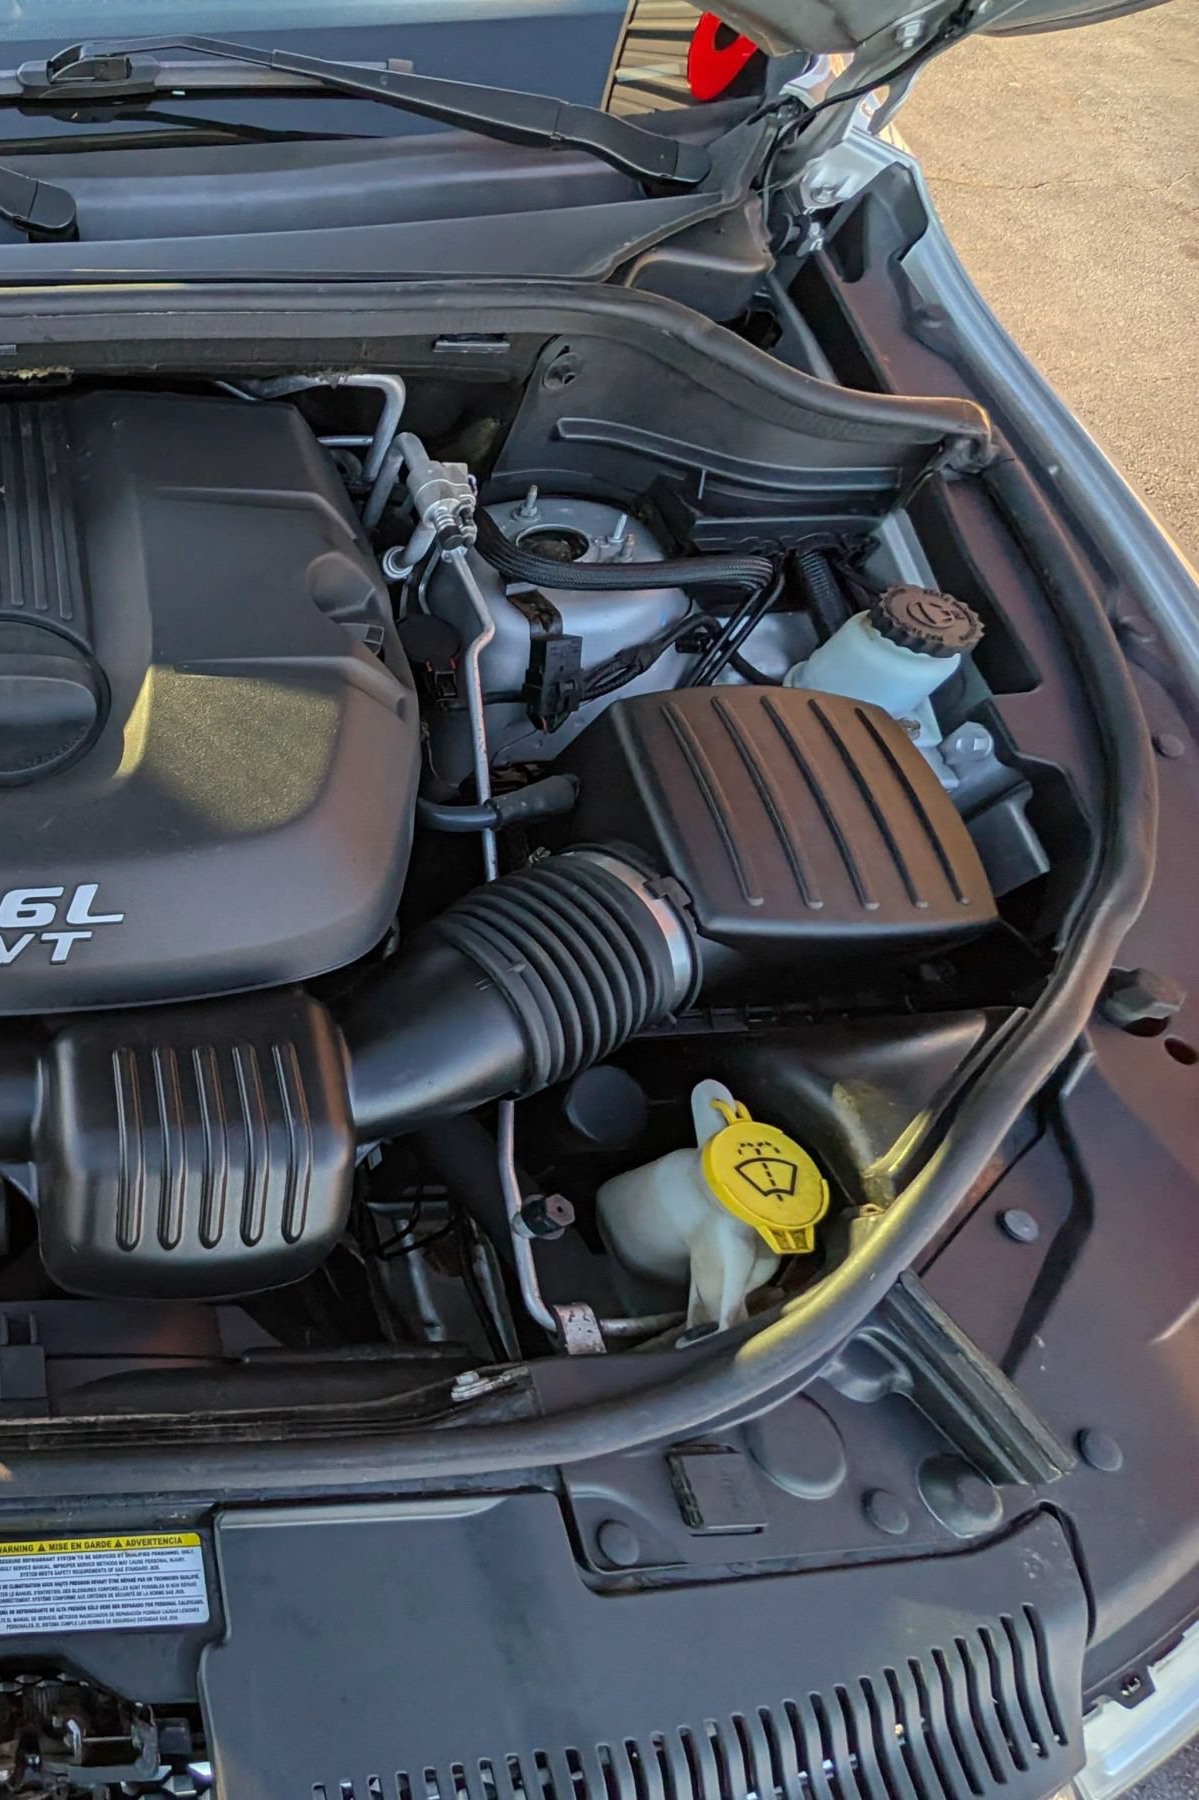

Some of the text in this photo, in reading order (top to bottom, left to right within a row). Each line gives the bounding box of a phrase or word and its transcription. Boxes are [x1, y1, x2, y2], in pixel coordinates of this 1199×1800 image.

[48, 1543, 68, 1551] MISE
[71, 1542, 82, 1550] EN
[84, 1541, 112, 1549] GARDE
[126, 1537, 183, 1547] ADVERTENCIA
[16, 1607, 48, 1615] REFRIGERANTE
